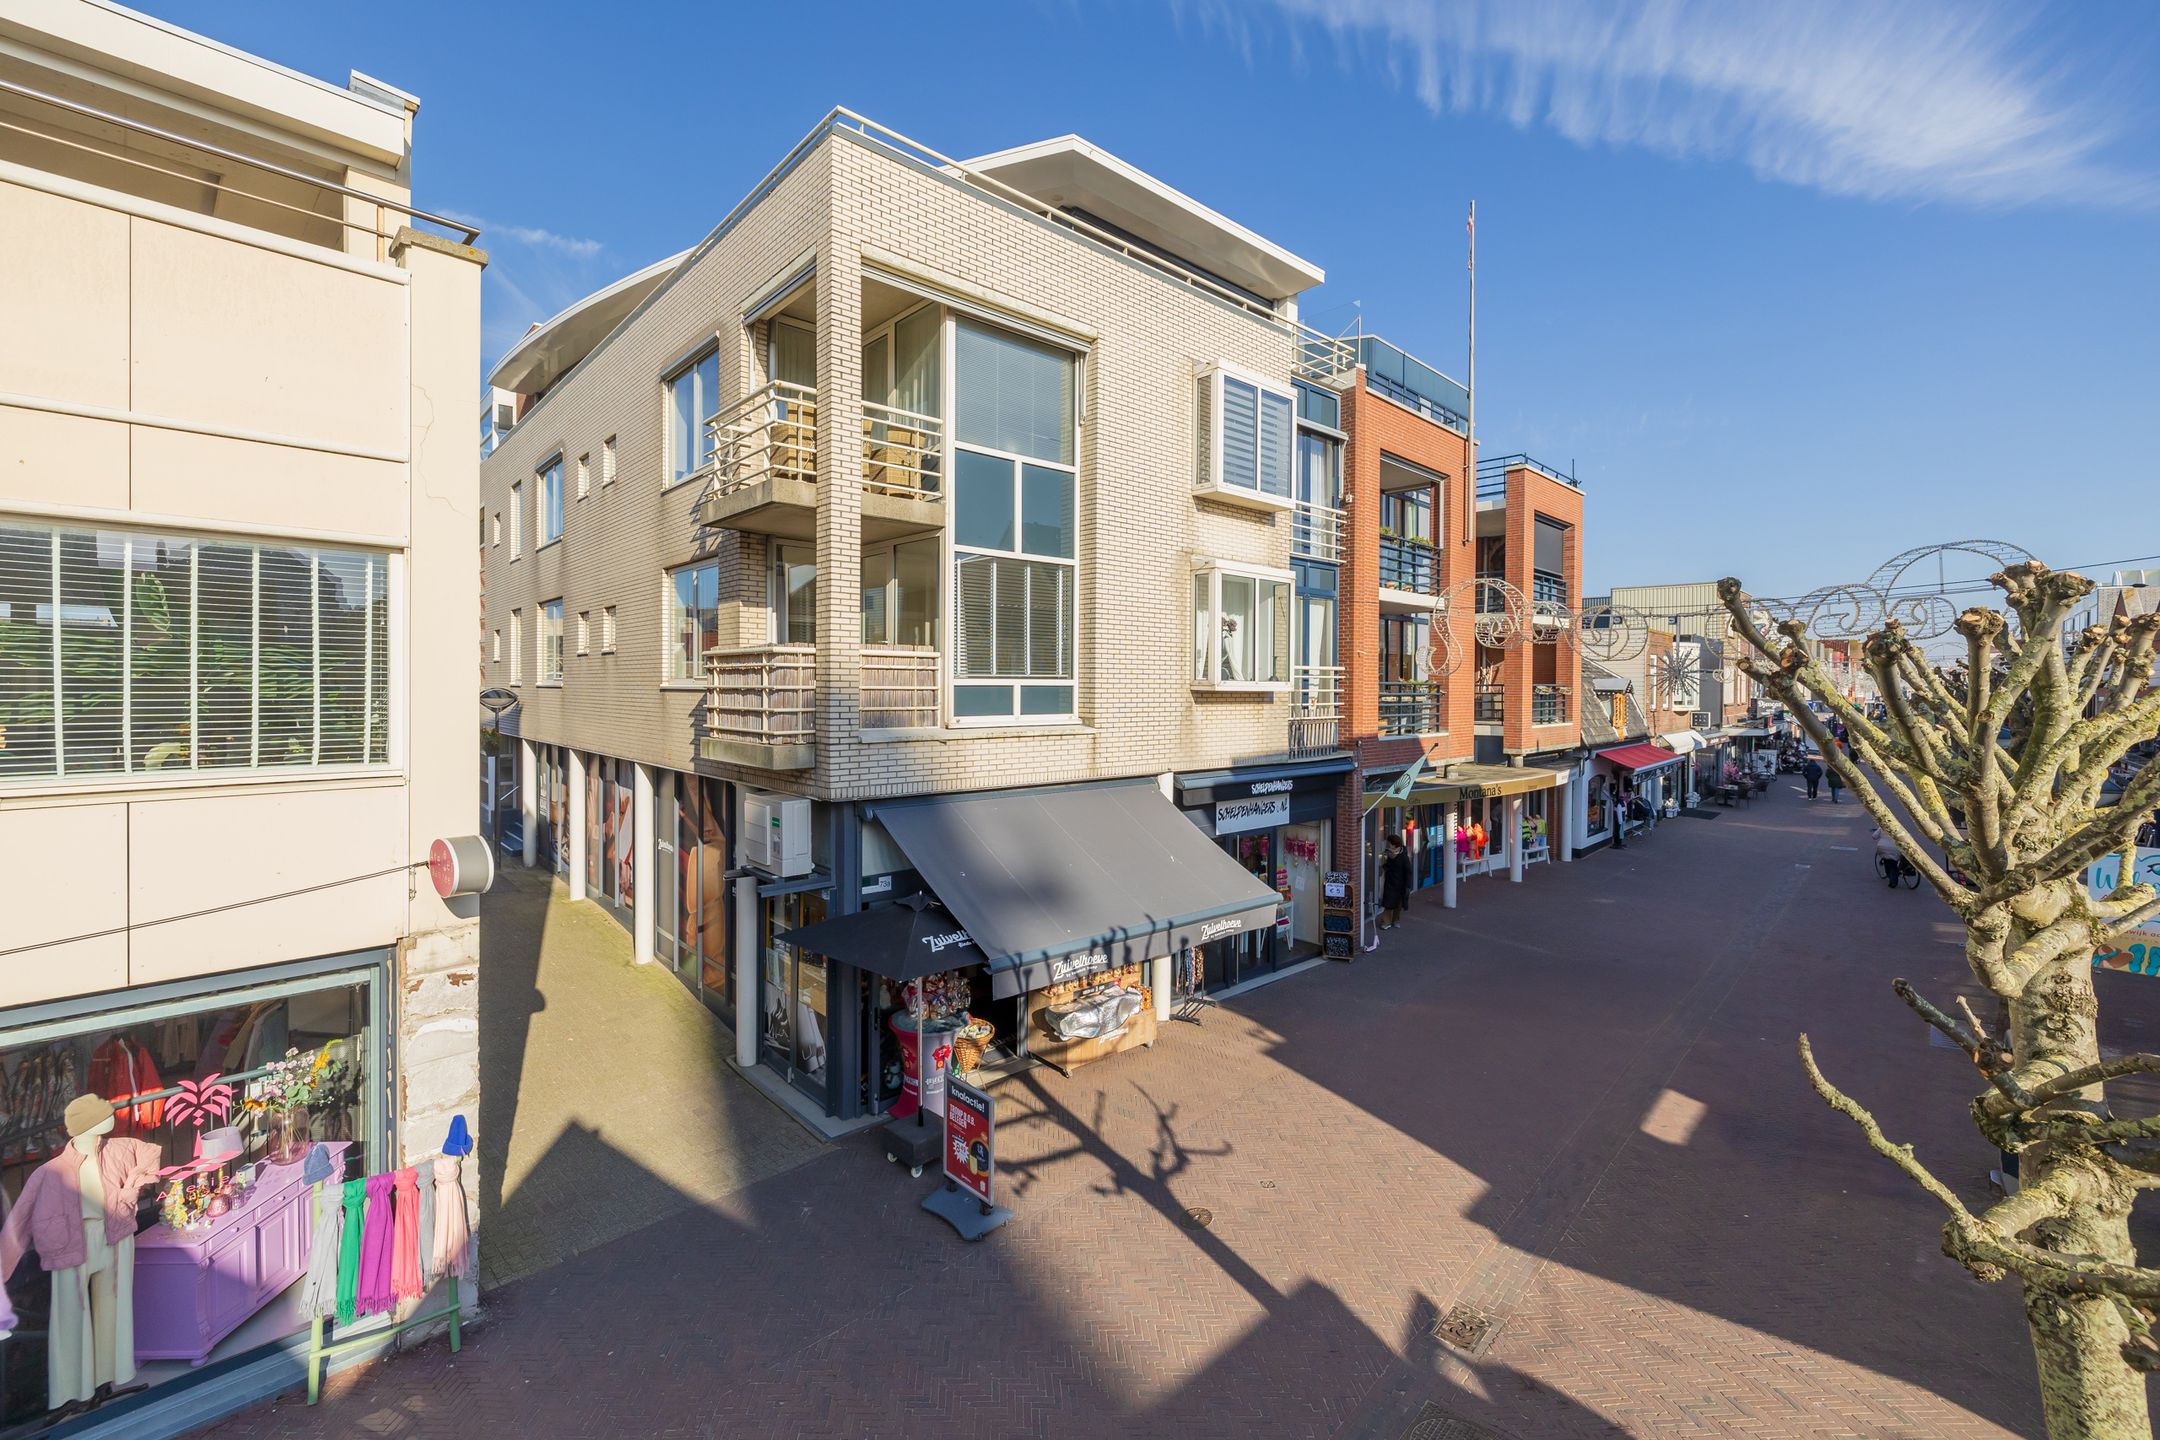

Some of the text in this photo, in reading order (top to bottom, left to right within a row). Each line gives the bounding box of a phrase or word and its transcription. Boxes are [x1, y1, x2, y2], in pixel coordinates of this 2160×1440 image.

[1460, 784, 1502, 800] Montana's
[1218, 800, 1276, 821] SCHELPENHANGERS
[1201, 919, 1242, 941] Zuivelhoeve
[921, 930, 973, 953] Zuivelh
[1053, 954, 1109, 982] Zuivelhoeve
[951, 1085, 985, 1113] knalactie!
